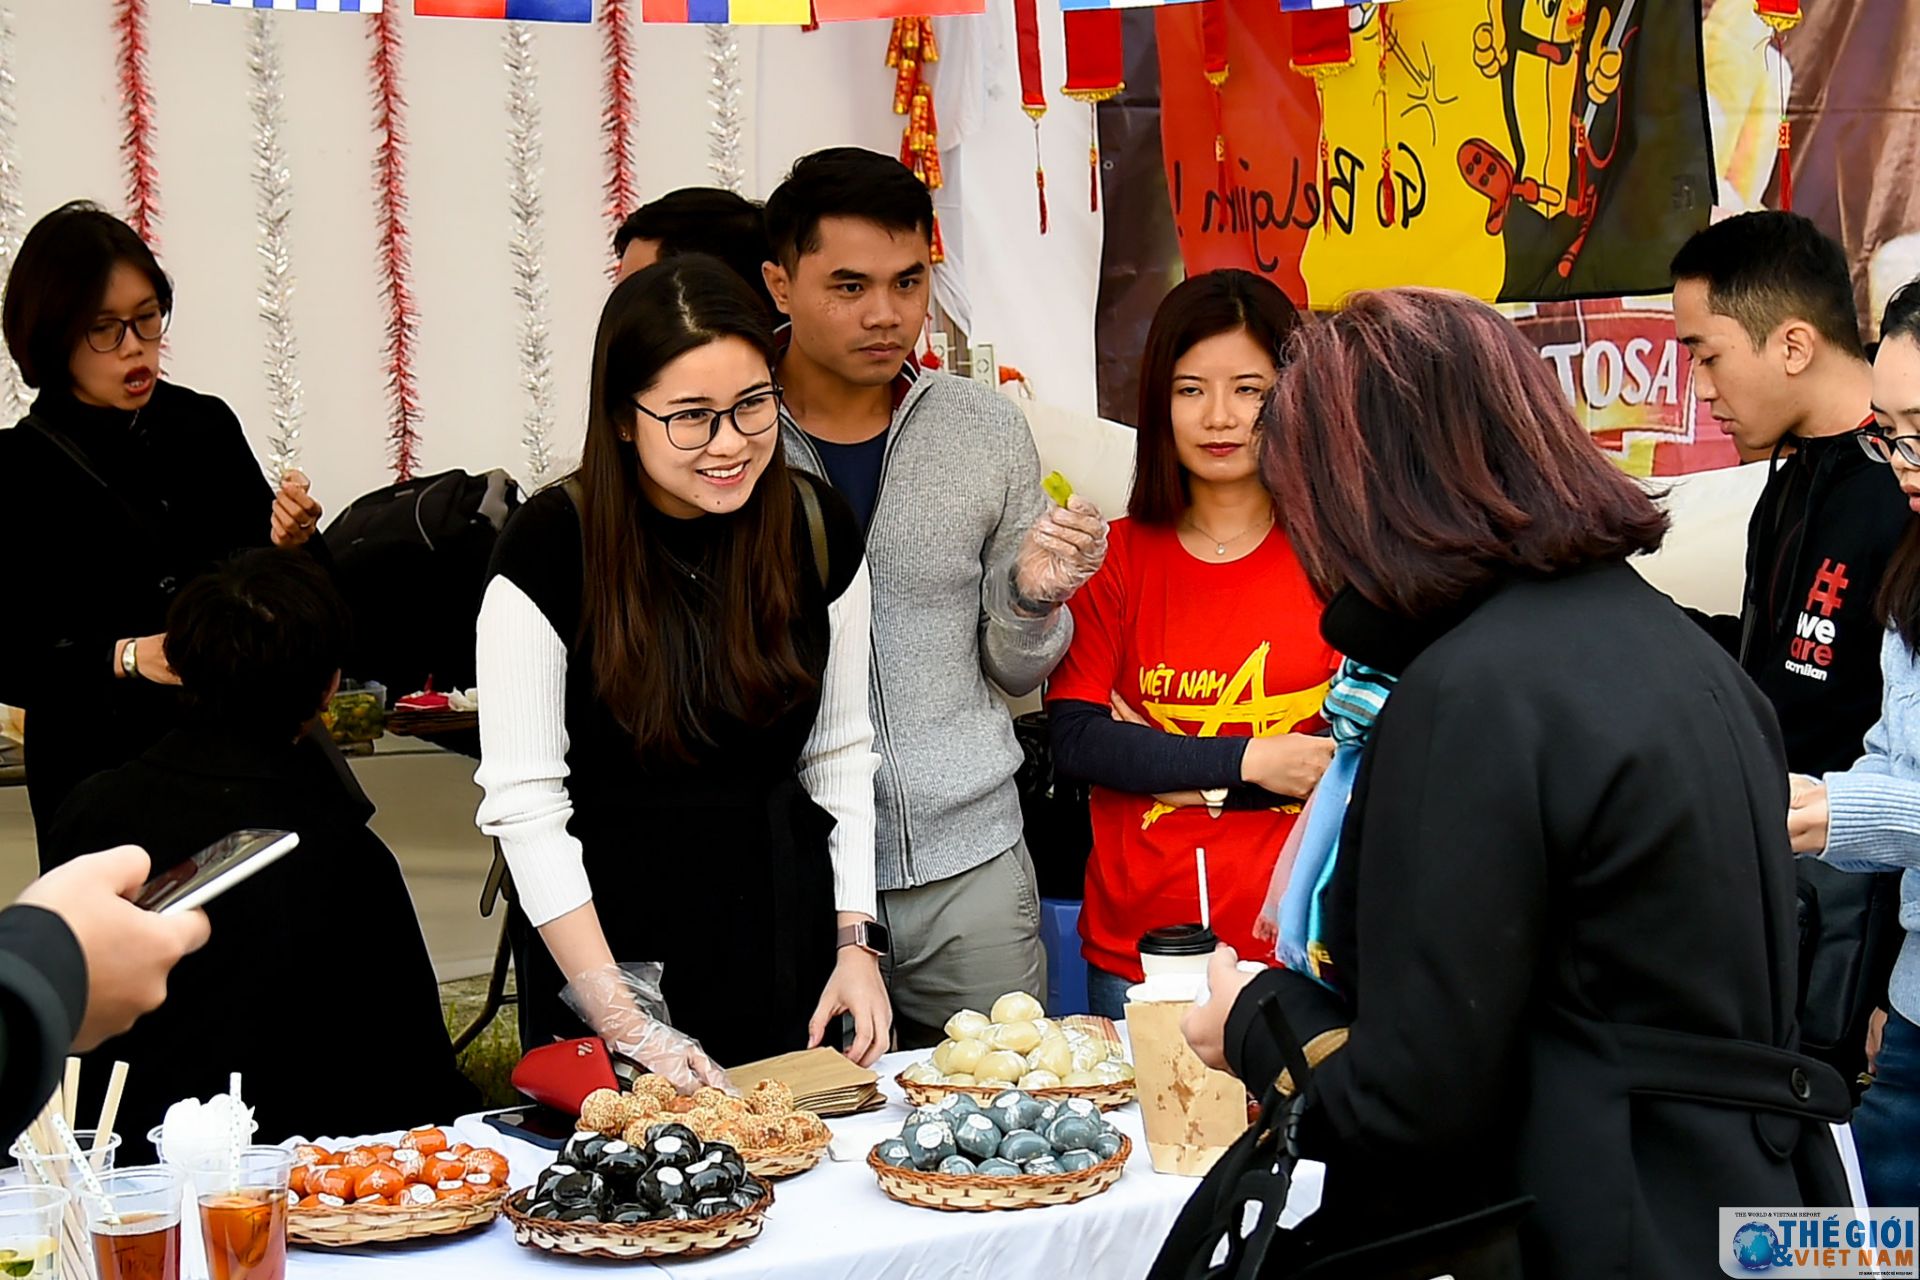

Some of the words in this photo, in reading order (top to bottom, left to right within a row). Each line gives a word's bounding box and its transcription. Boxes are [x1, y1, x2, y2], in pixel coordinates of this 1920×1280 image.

[1533, 337, 1679, 408] TOSA
[1796, 611, 1836, 645] we
[1791, 636, 1833, 666] are
[1176, 669, 1227, 699] NAM
